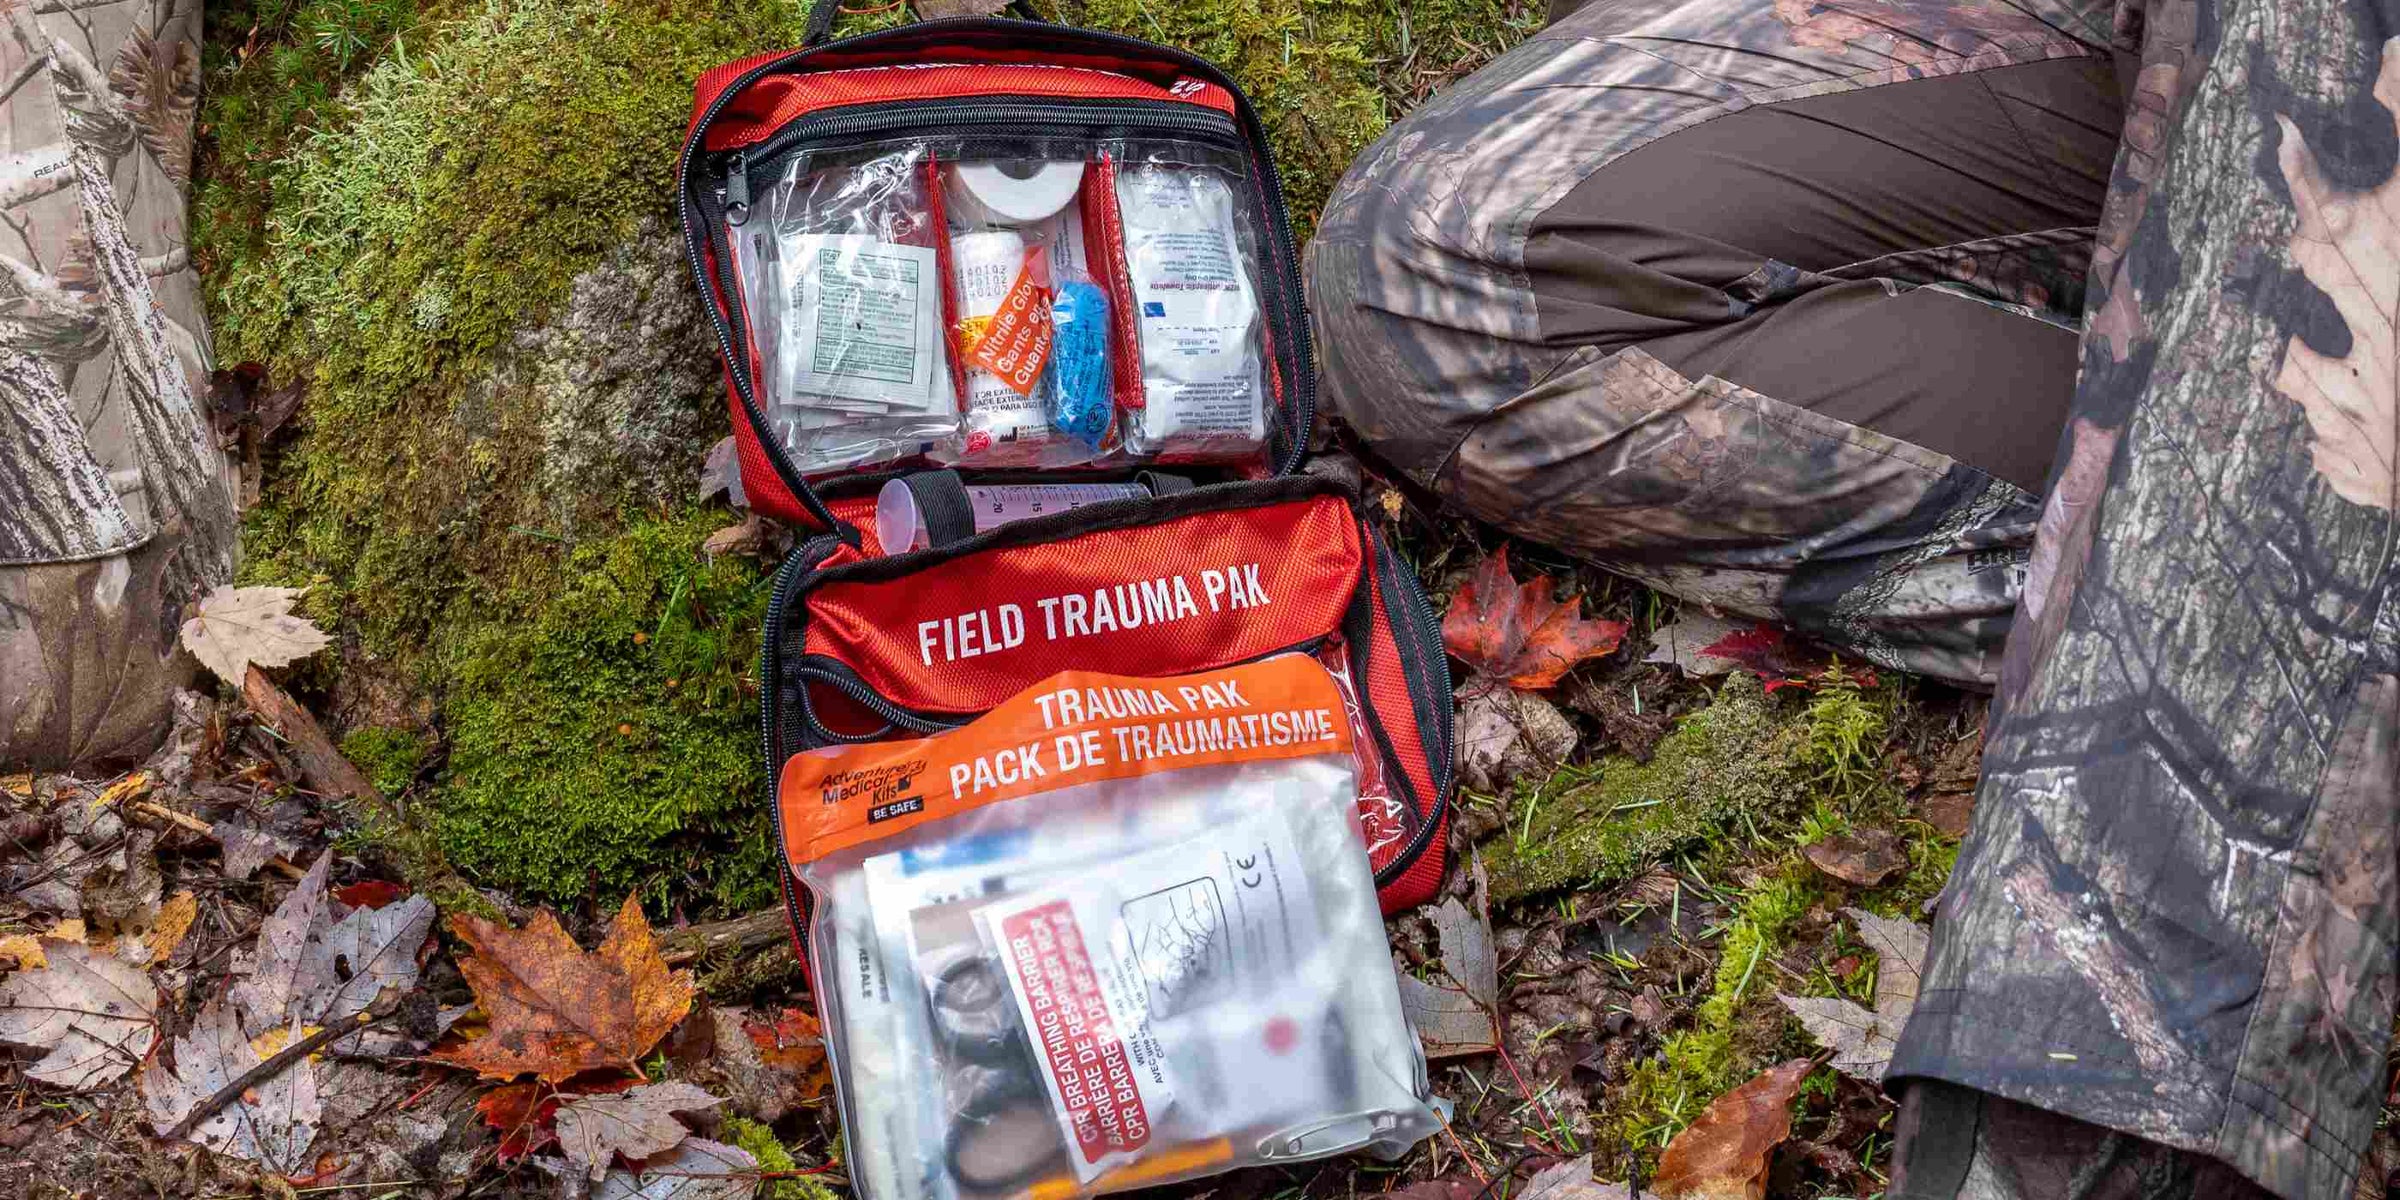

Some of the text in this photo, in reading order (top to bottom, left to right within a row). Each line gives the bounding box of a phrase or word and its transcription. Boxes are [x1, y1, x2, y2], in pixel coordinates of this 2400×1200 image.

[978, 311, 1017, 363] Nitrile
[997, 326, 1032, 373] Gants
[918, 563, 1271, 666] FIELD TRAUMA PAK
[1034, 680, 1250, 730] TRAUMA PAK
[949, 709, 1337, 800] PACK DE TRAUMATISME
[823, 773, 889, 805] Medical
[873, 785, 897, 805] Kits
[873, 799, 918, 820] BE SAFE
[1012, 936, 1052, 1010] BARRIER
[1041, 1011, 1088, 1109] BREATHING
[1074, 1037, 1098, 1064] DE
[1093, 1020, 1135, 1104] BARRERA
[1148, 1059, 1164, 1084] AVEC
[1075, 1108, 1098, 1143] CPR
[1122, 1103, 1146, 1140] CPR
